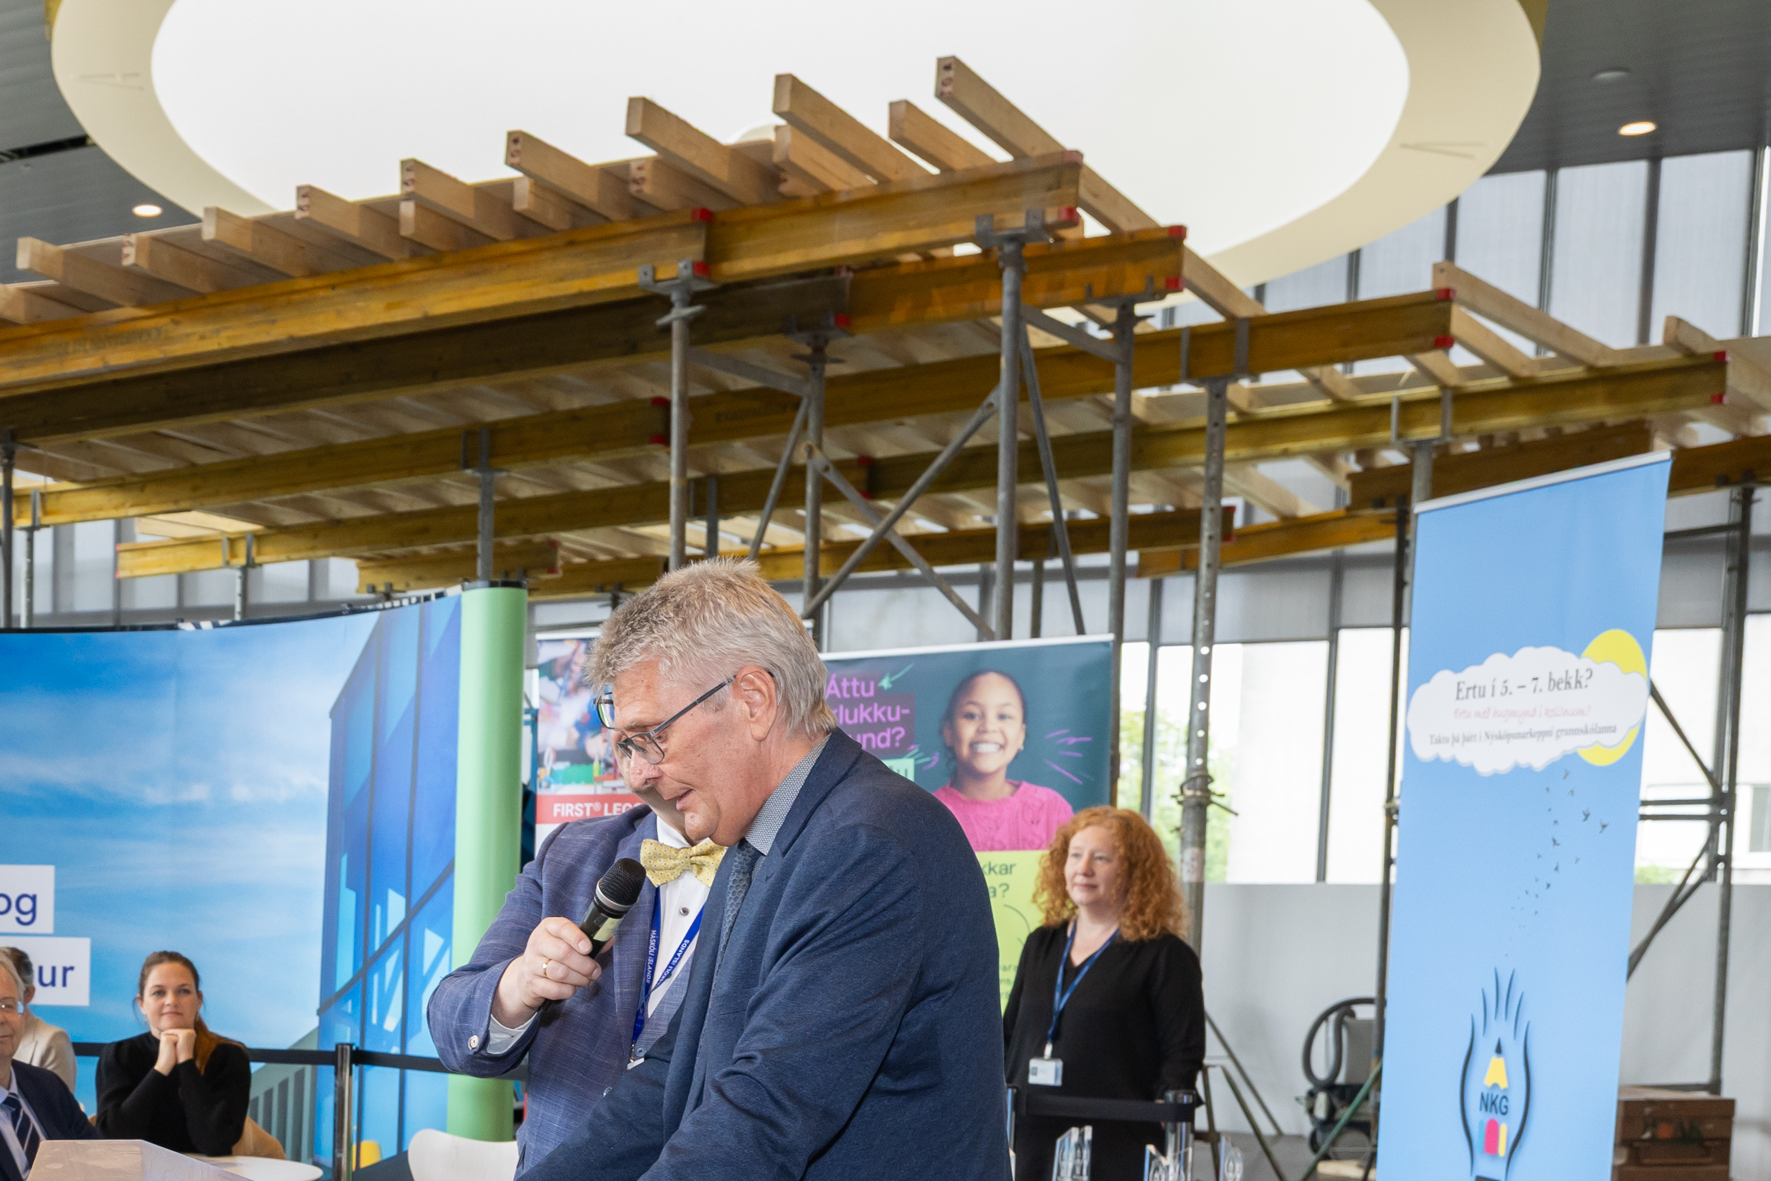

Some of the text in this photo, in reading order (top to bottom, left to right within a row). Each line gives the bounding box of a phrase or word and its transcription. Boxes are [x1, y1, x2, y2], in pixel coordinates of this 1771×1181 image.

[825, 673, 875, 699] Áttu
[1455, 680, 1486, 701] Ertu
[1491, 677, 1496, 698] í
[1500, 679, 1512, 697] 5.
[1531, 677, 1543, 694] 7.
[1547, 668, 1594, 692] bekk?
[831, 702, 910, 725] lukku-
[1479, 1091, 1509, 1116] NKG
